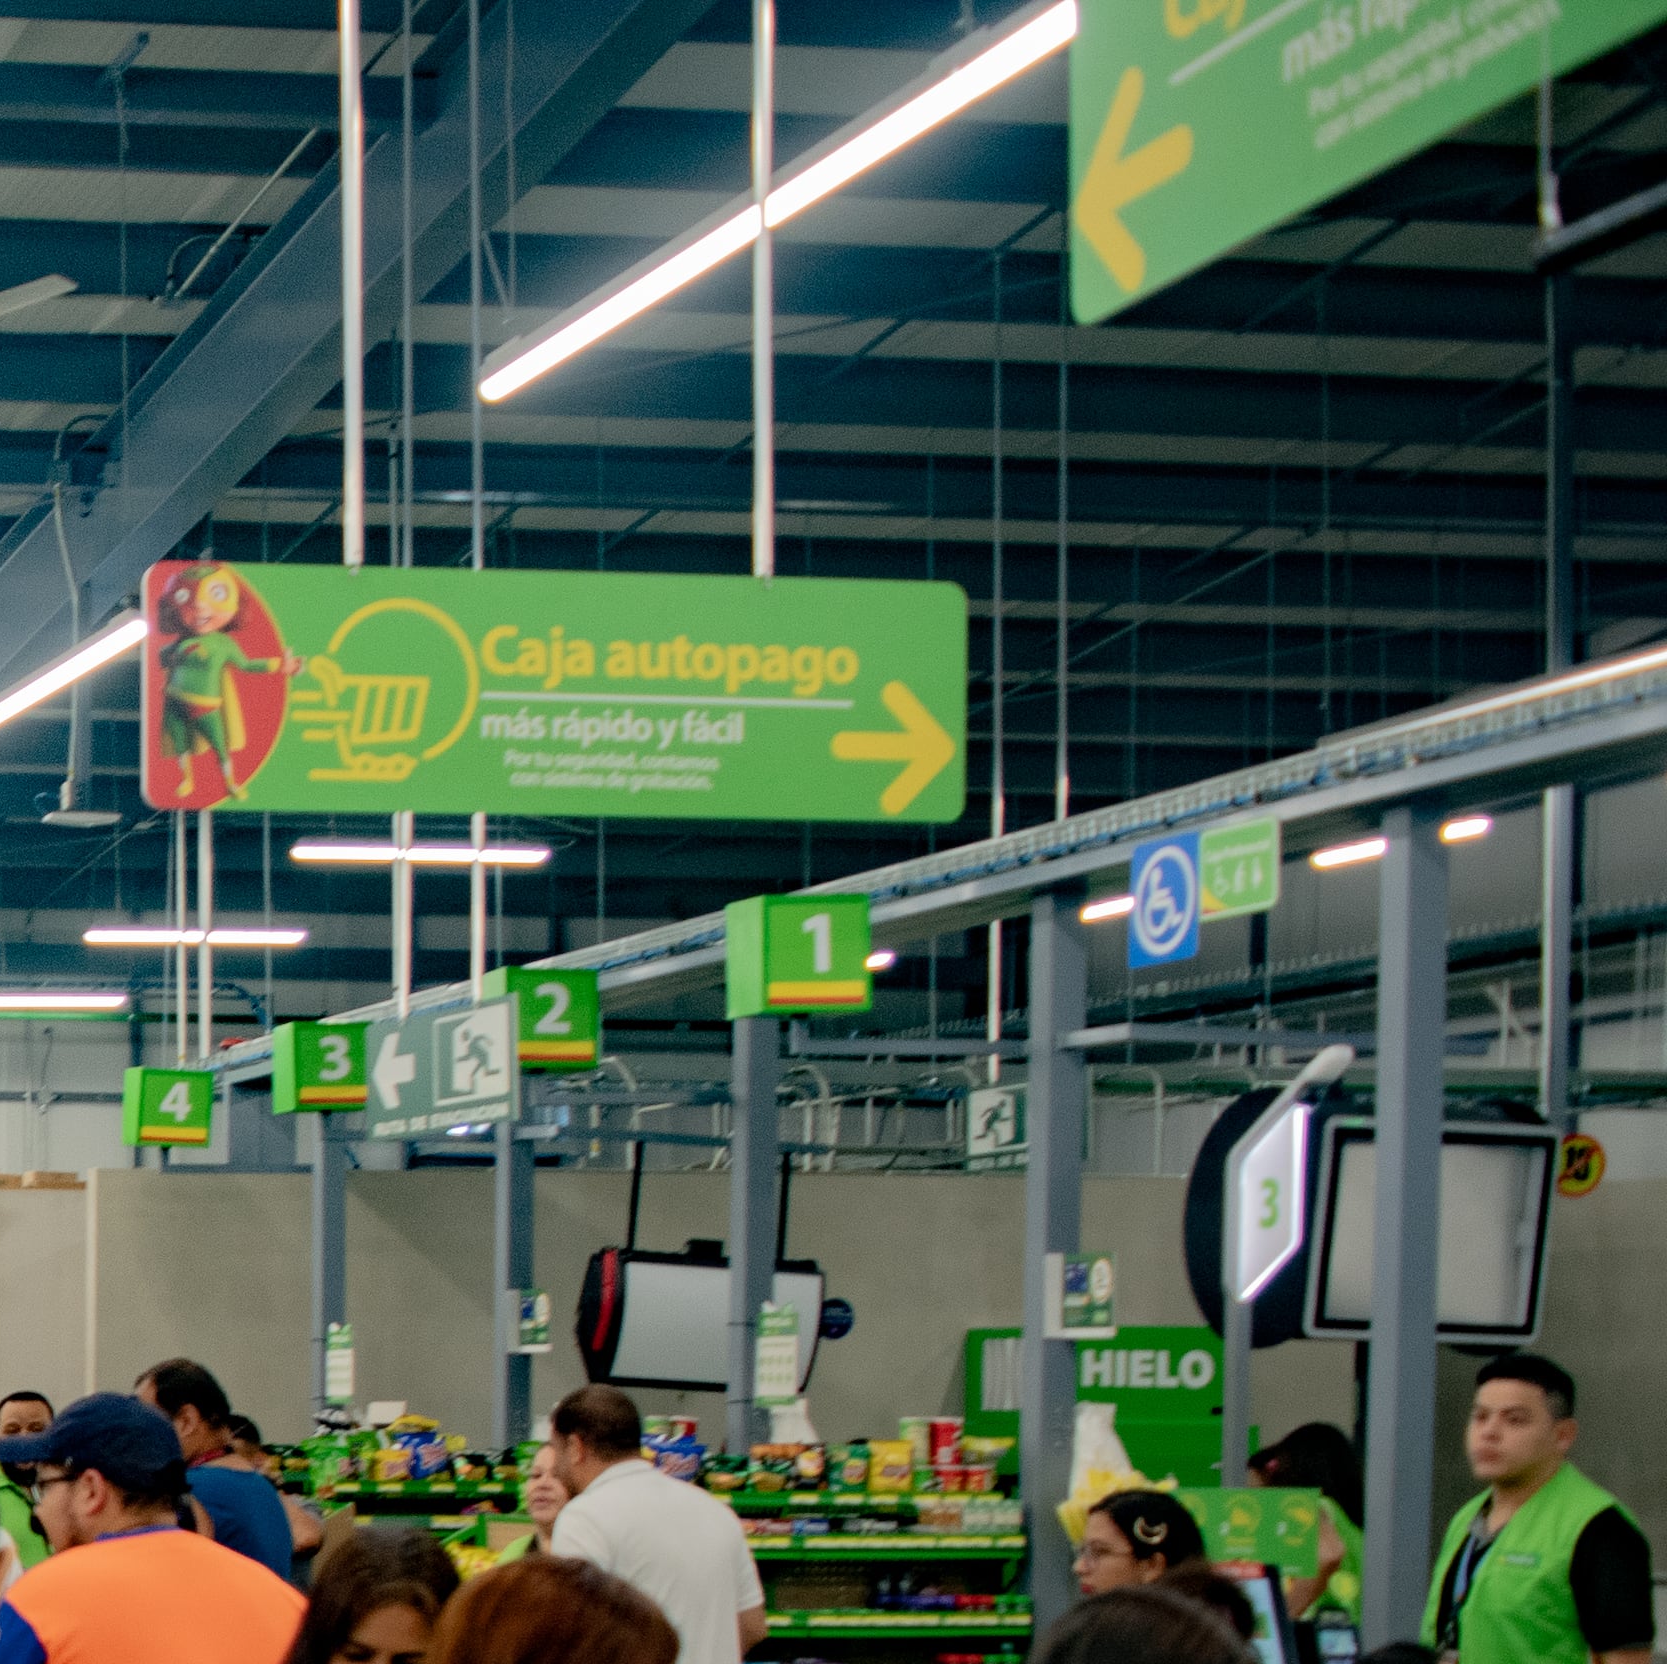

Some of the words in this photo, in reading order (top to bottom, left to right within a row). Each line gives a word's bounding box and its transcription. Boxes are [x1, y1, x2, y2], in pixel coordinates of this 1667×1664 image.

[480, 624, 595, 691] Caja
[605, 634, 860, 697] autopago
[480, 706, 546, 739] más
[551, 708, 655, 750] rápido
[657, 719, 677, 751] y
[681, 711, 746, 744] fácil
[800, 914, 833, 973] 1
[535, 983, 571, 1036] 2
[318, 1035, 351, 1078] 3
[160, 1083, 192, 1120] 4
[1259, 1178, 1280, 1228] 3
[1081, 1348, 1214, 1389] HIELO
